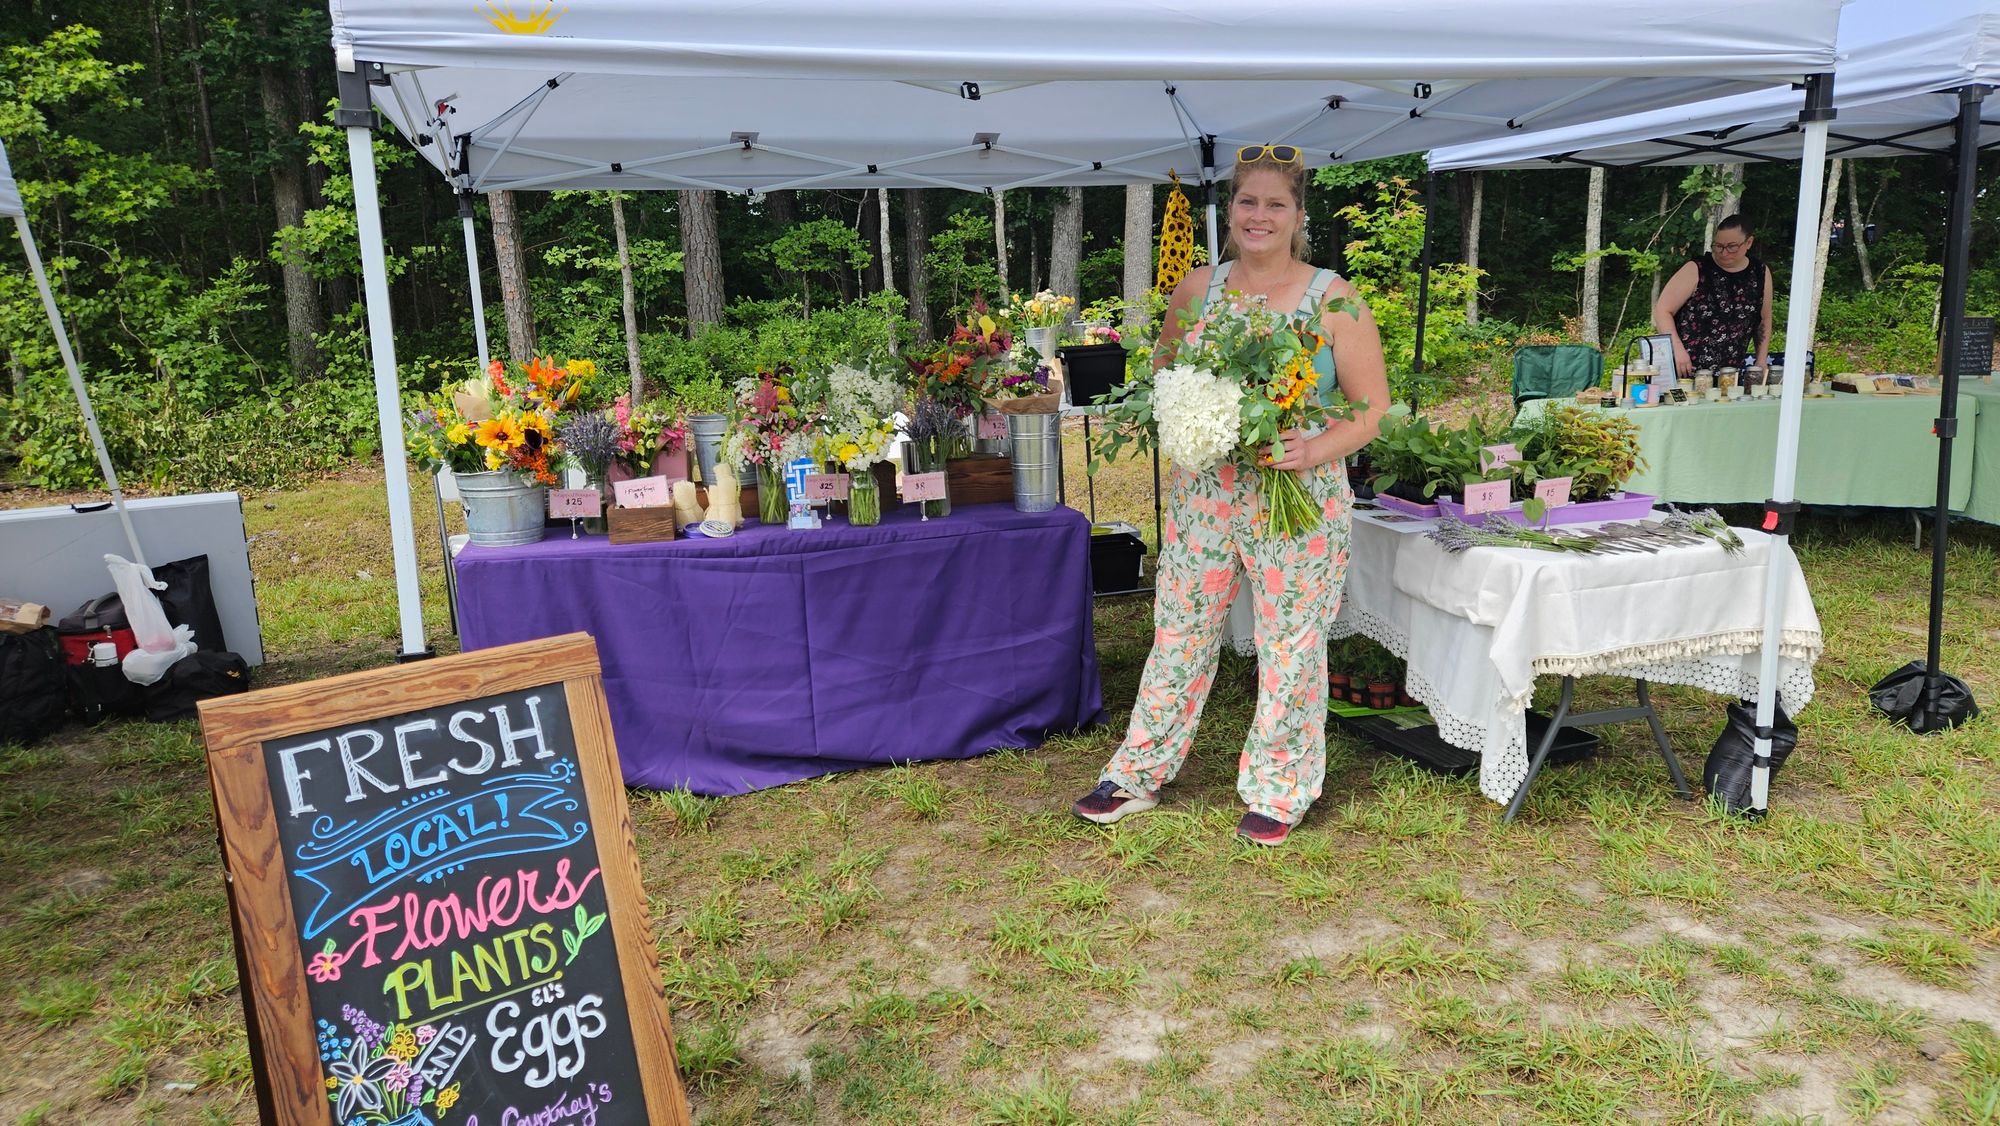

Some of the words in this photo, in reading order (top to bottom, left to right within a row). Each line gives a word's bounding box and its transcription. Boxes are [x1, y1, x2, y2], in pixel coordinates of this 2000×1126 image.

[565, 497, 583, 506] $25
[819, 482, 834, 490] $25
[915, 481, 926, 490] $8
[1482, 491, 1493, 501] $8
[277, 696, 556, 818] FRESH
[350, 793, 510, 884] LOCAL!
[341, 858, 600, 968] Flowers
[383, 922, 557, 1019] PLANTS
[421, 1025, 468, 1087] AND
[486, 994, 607, 1088] Eggs
[501, 1082, 613, 1126] Courtney's
